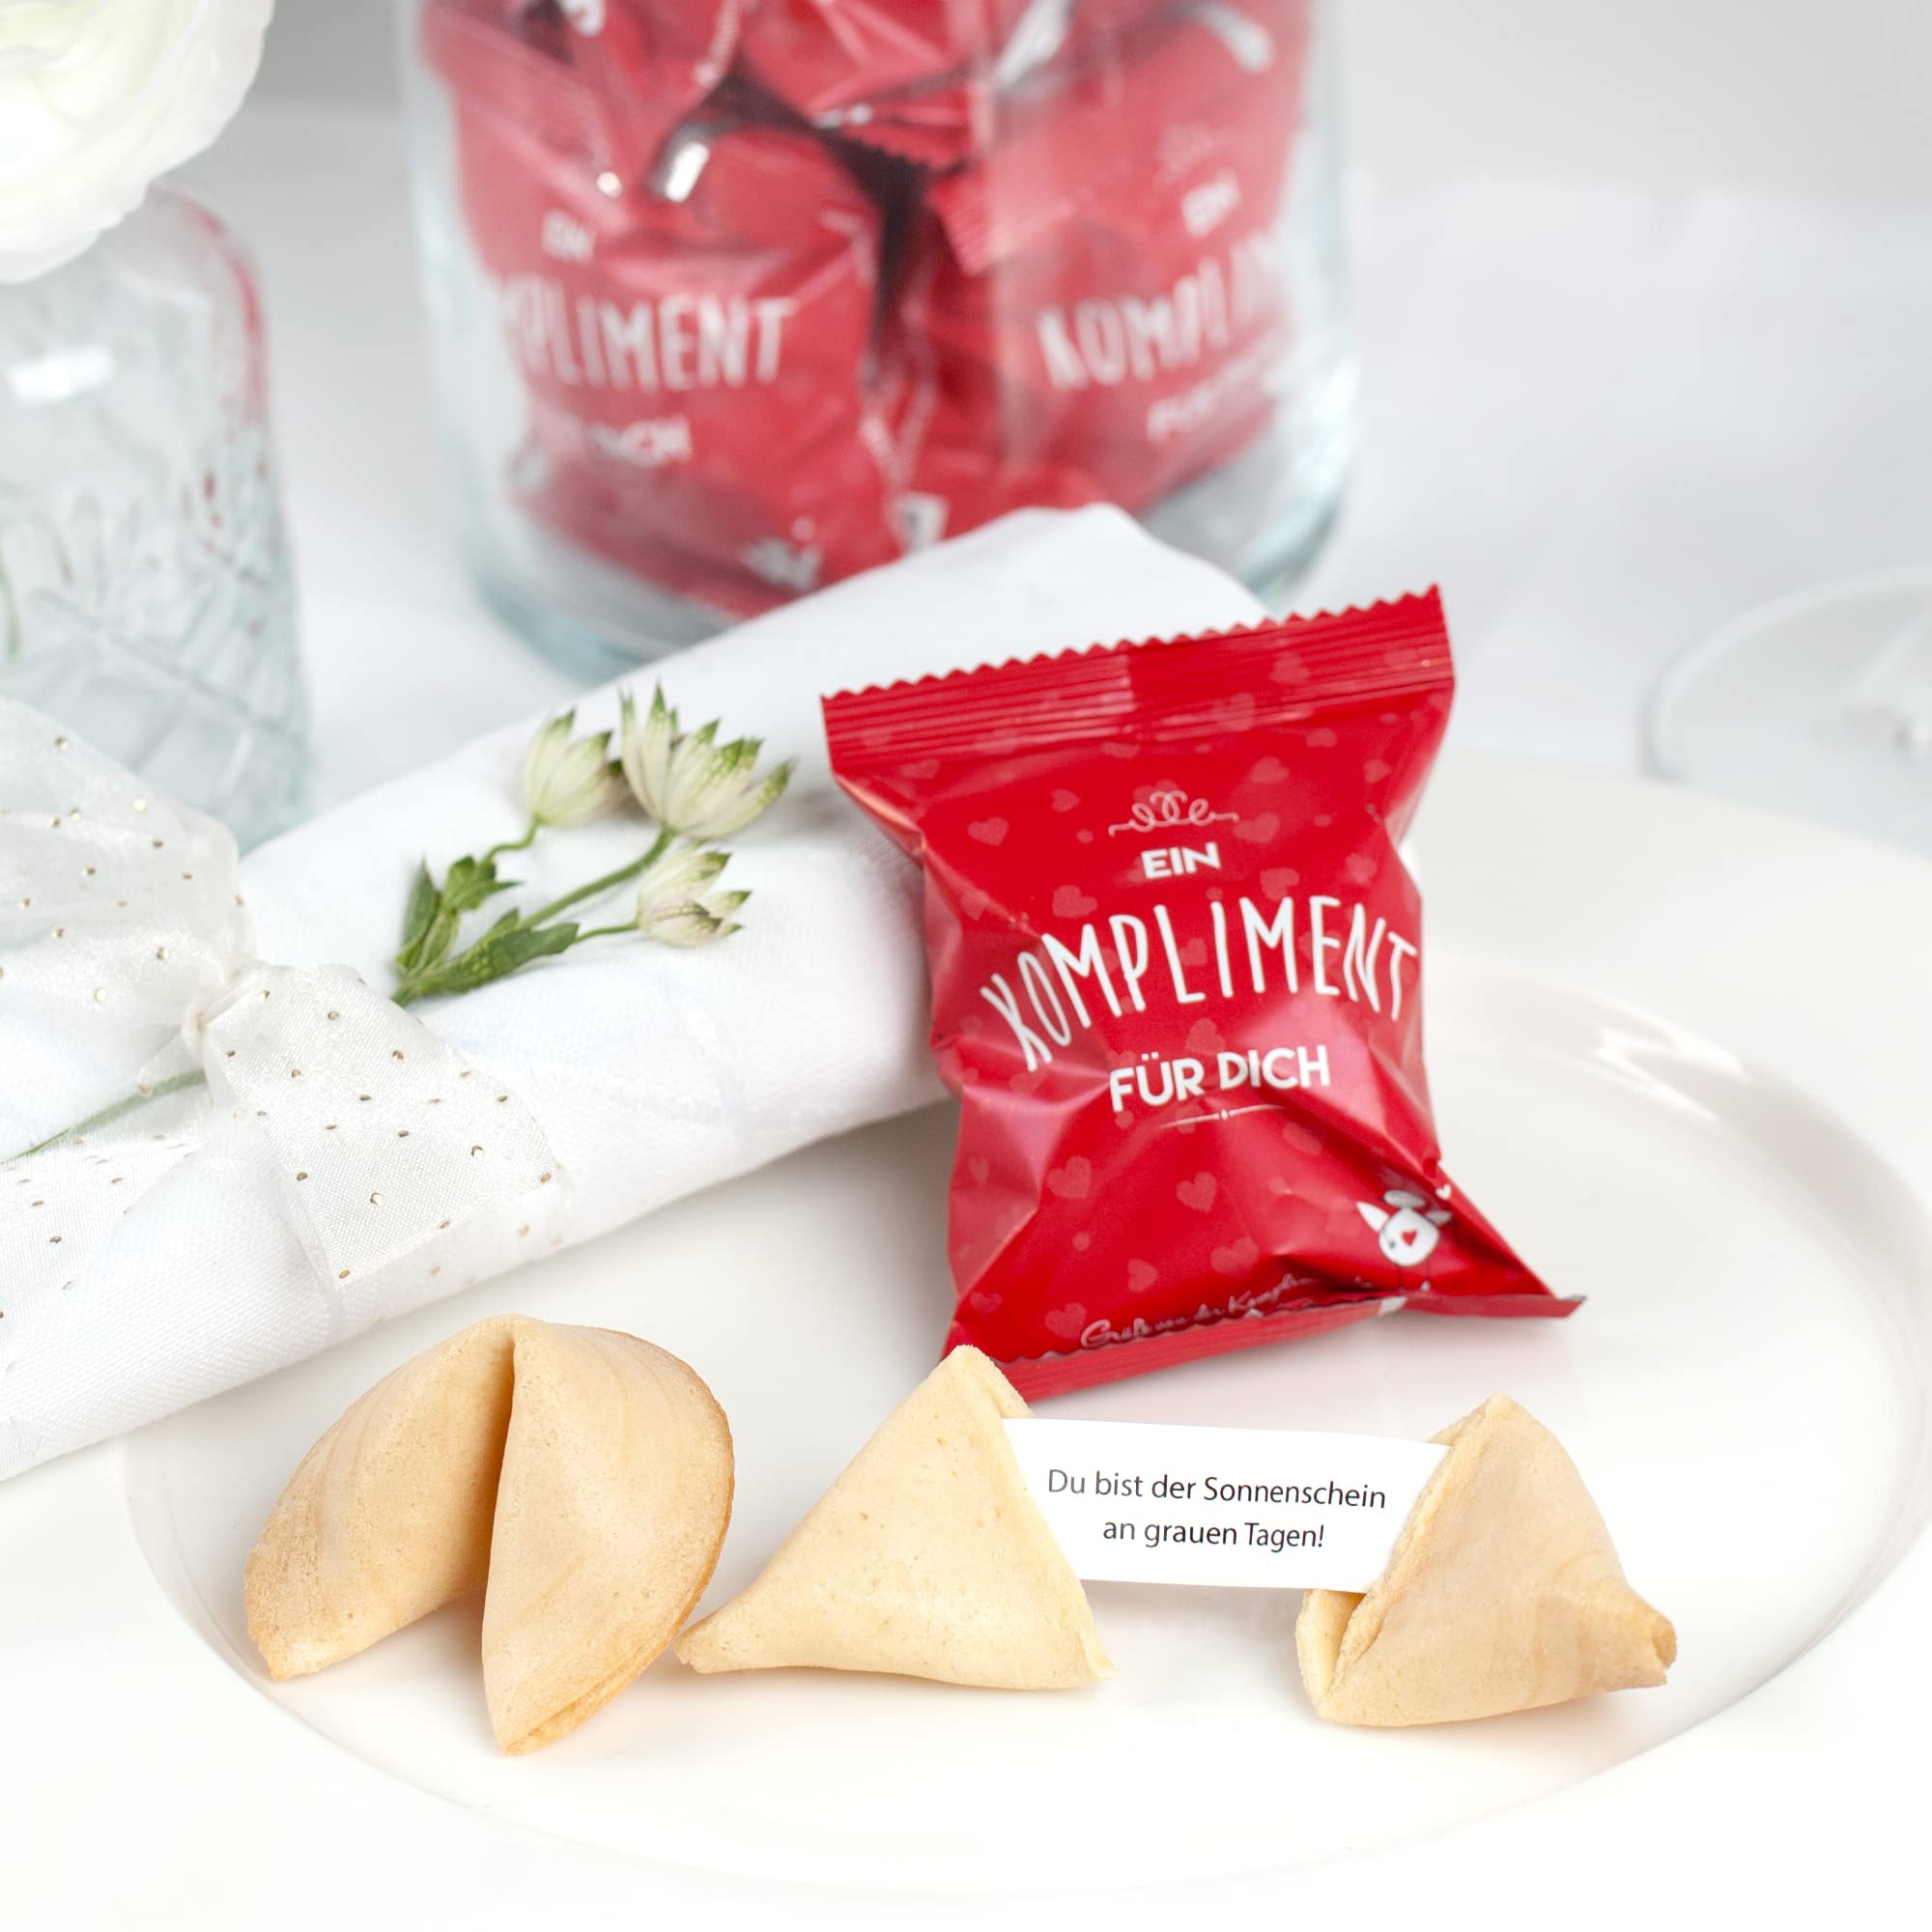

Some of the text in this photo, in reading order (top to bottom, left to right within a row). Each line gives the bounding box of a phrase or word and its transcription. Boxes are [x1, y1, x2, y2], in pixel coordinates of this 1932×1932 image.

[1141, 841, 1221, 879] EIN
[980, 895, 1419, 1073] KOMPLIMENT
[1108, 1044, 1332, 1113] FÜR DICH
[1047, 1468, 1386, 1509] Du bist der Sonnenschein
[1102, 1520, 1324, 1553] an grauen Tagen!
